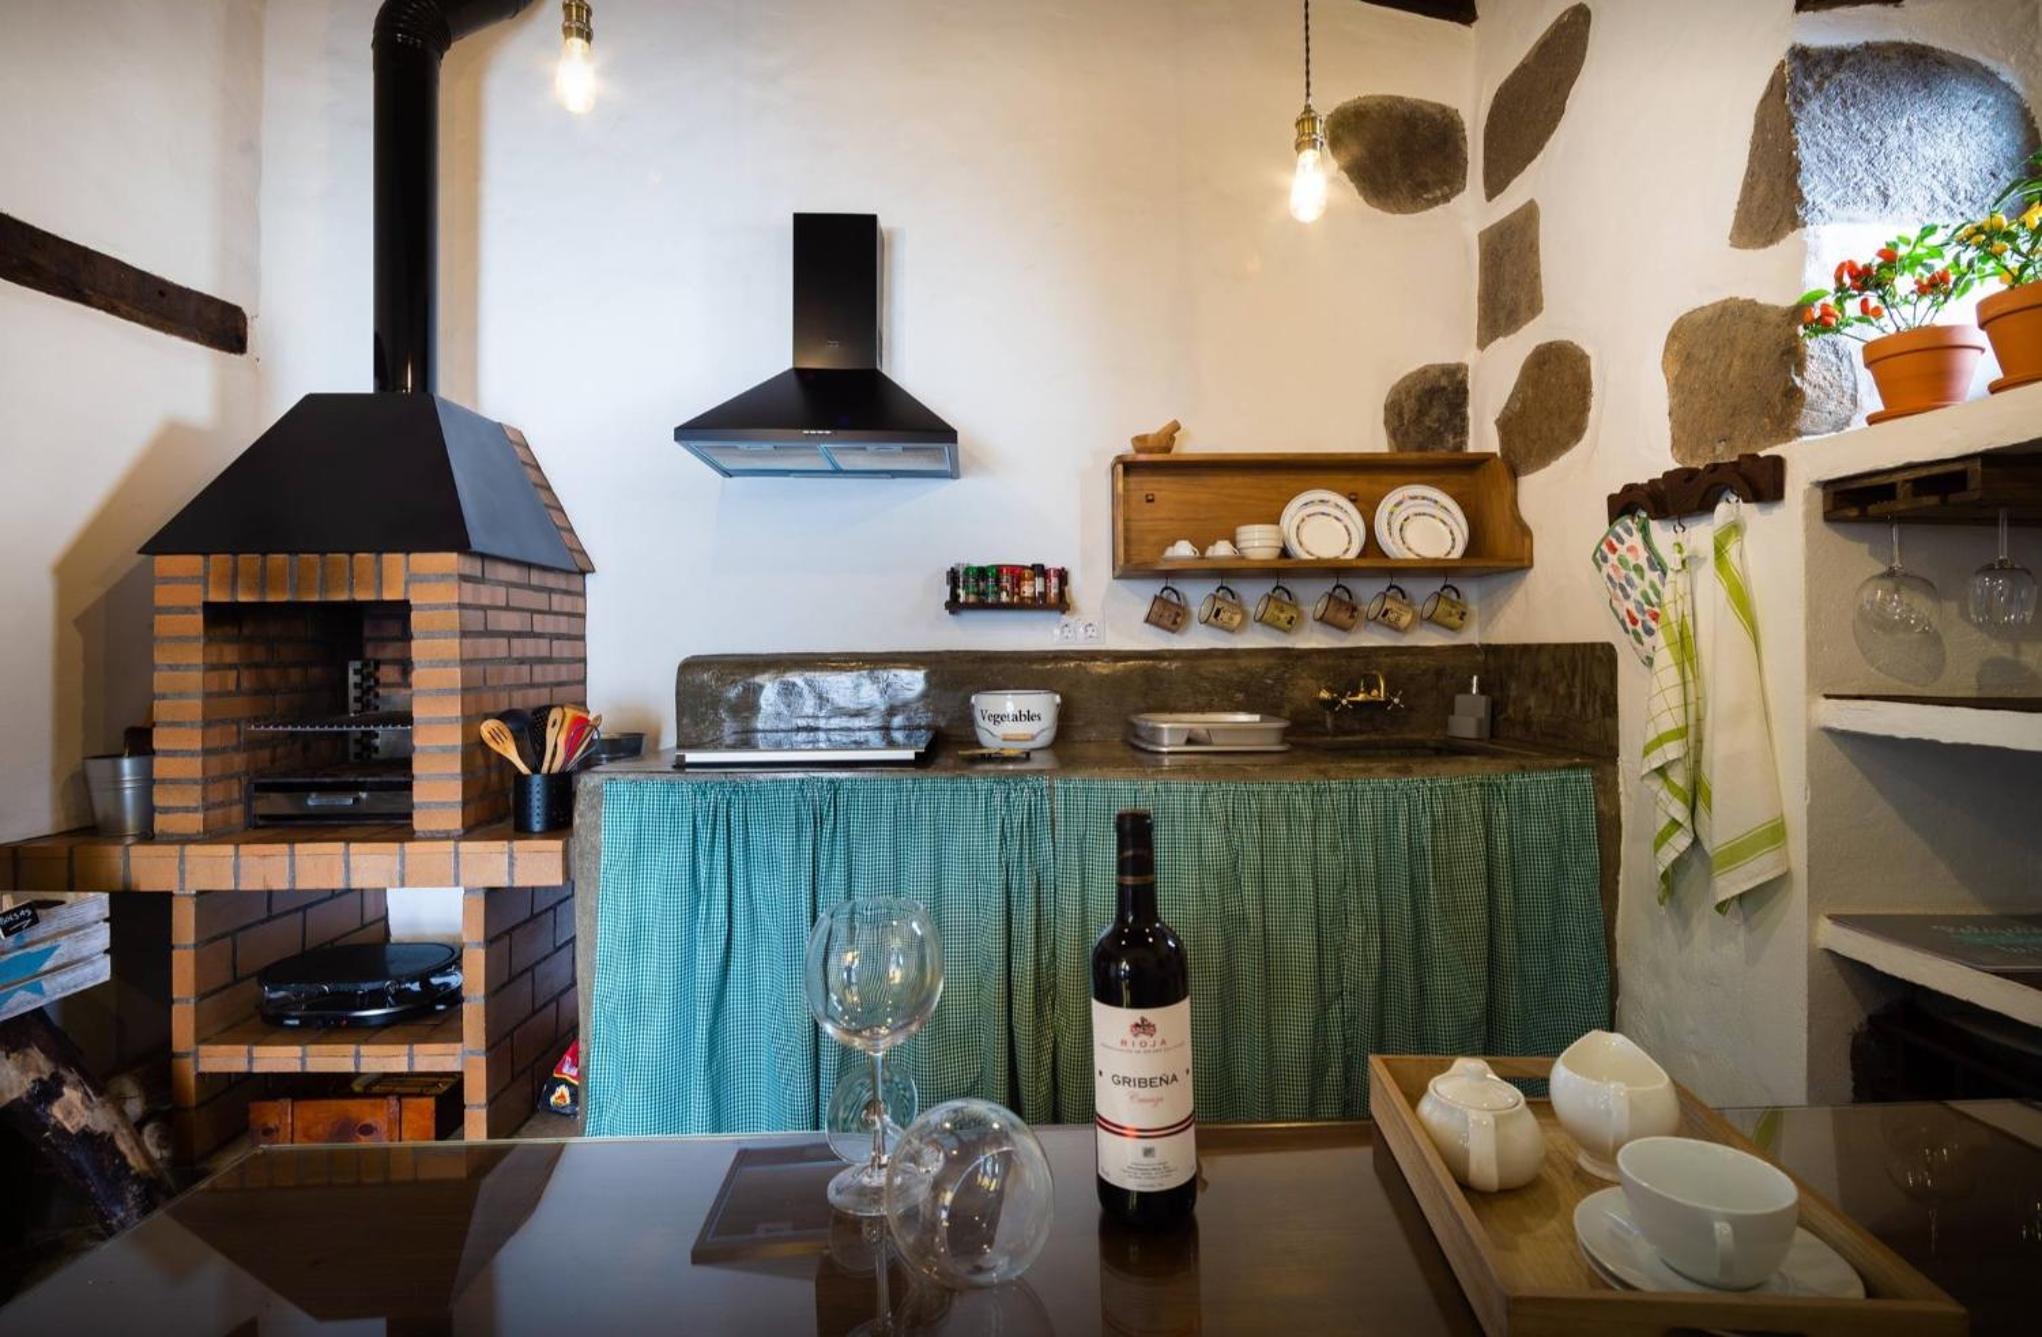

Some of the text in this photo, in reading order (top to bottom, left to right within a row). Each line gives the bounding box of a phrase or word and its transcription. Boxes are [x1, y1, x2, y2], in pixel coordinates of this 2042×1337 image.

[981, 709, 1041, 725] Vegetables
[1121, 1038, 1167, 1048] RIOJA
[1111, 1073, 1179, 1088] GRIBEÑA
